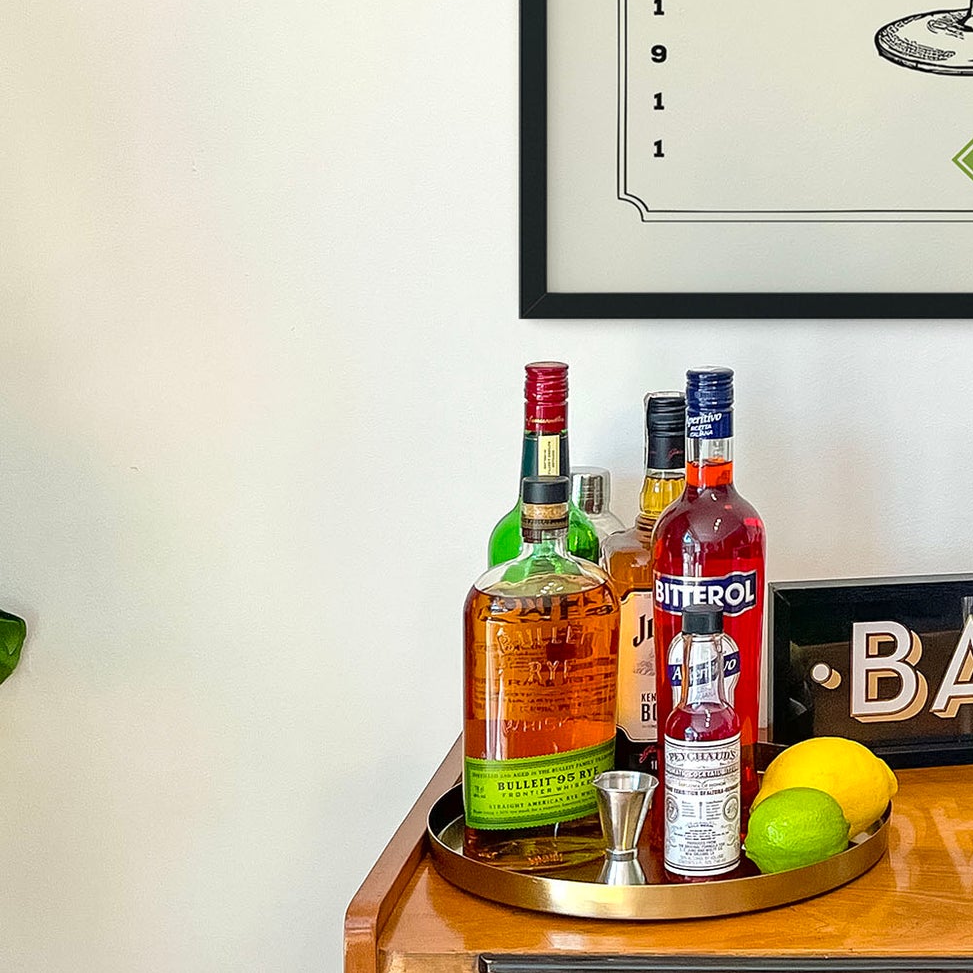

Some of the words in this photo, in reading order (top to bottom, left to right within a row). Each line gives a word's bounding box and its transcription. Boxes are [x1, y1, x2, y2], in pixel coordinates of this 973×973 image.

[687, 412, 722, 427] peritivo
[655, 579, 755, 608] BITTEROL
[497, 777, 551, 791] BULLEIT
[557, 772, 576, 784] 95
[579, 766, 599, 779] RYE
[502, 788, 552, 798] FRONTIER
[556, 780, 594, 792] WHISKE
[528, 797, 564, 807] AMERICAN
